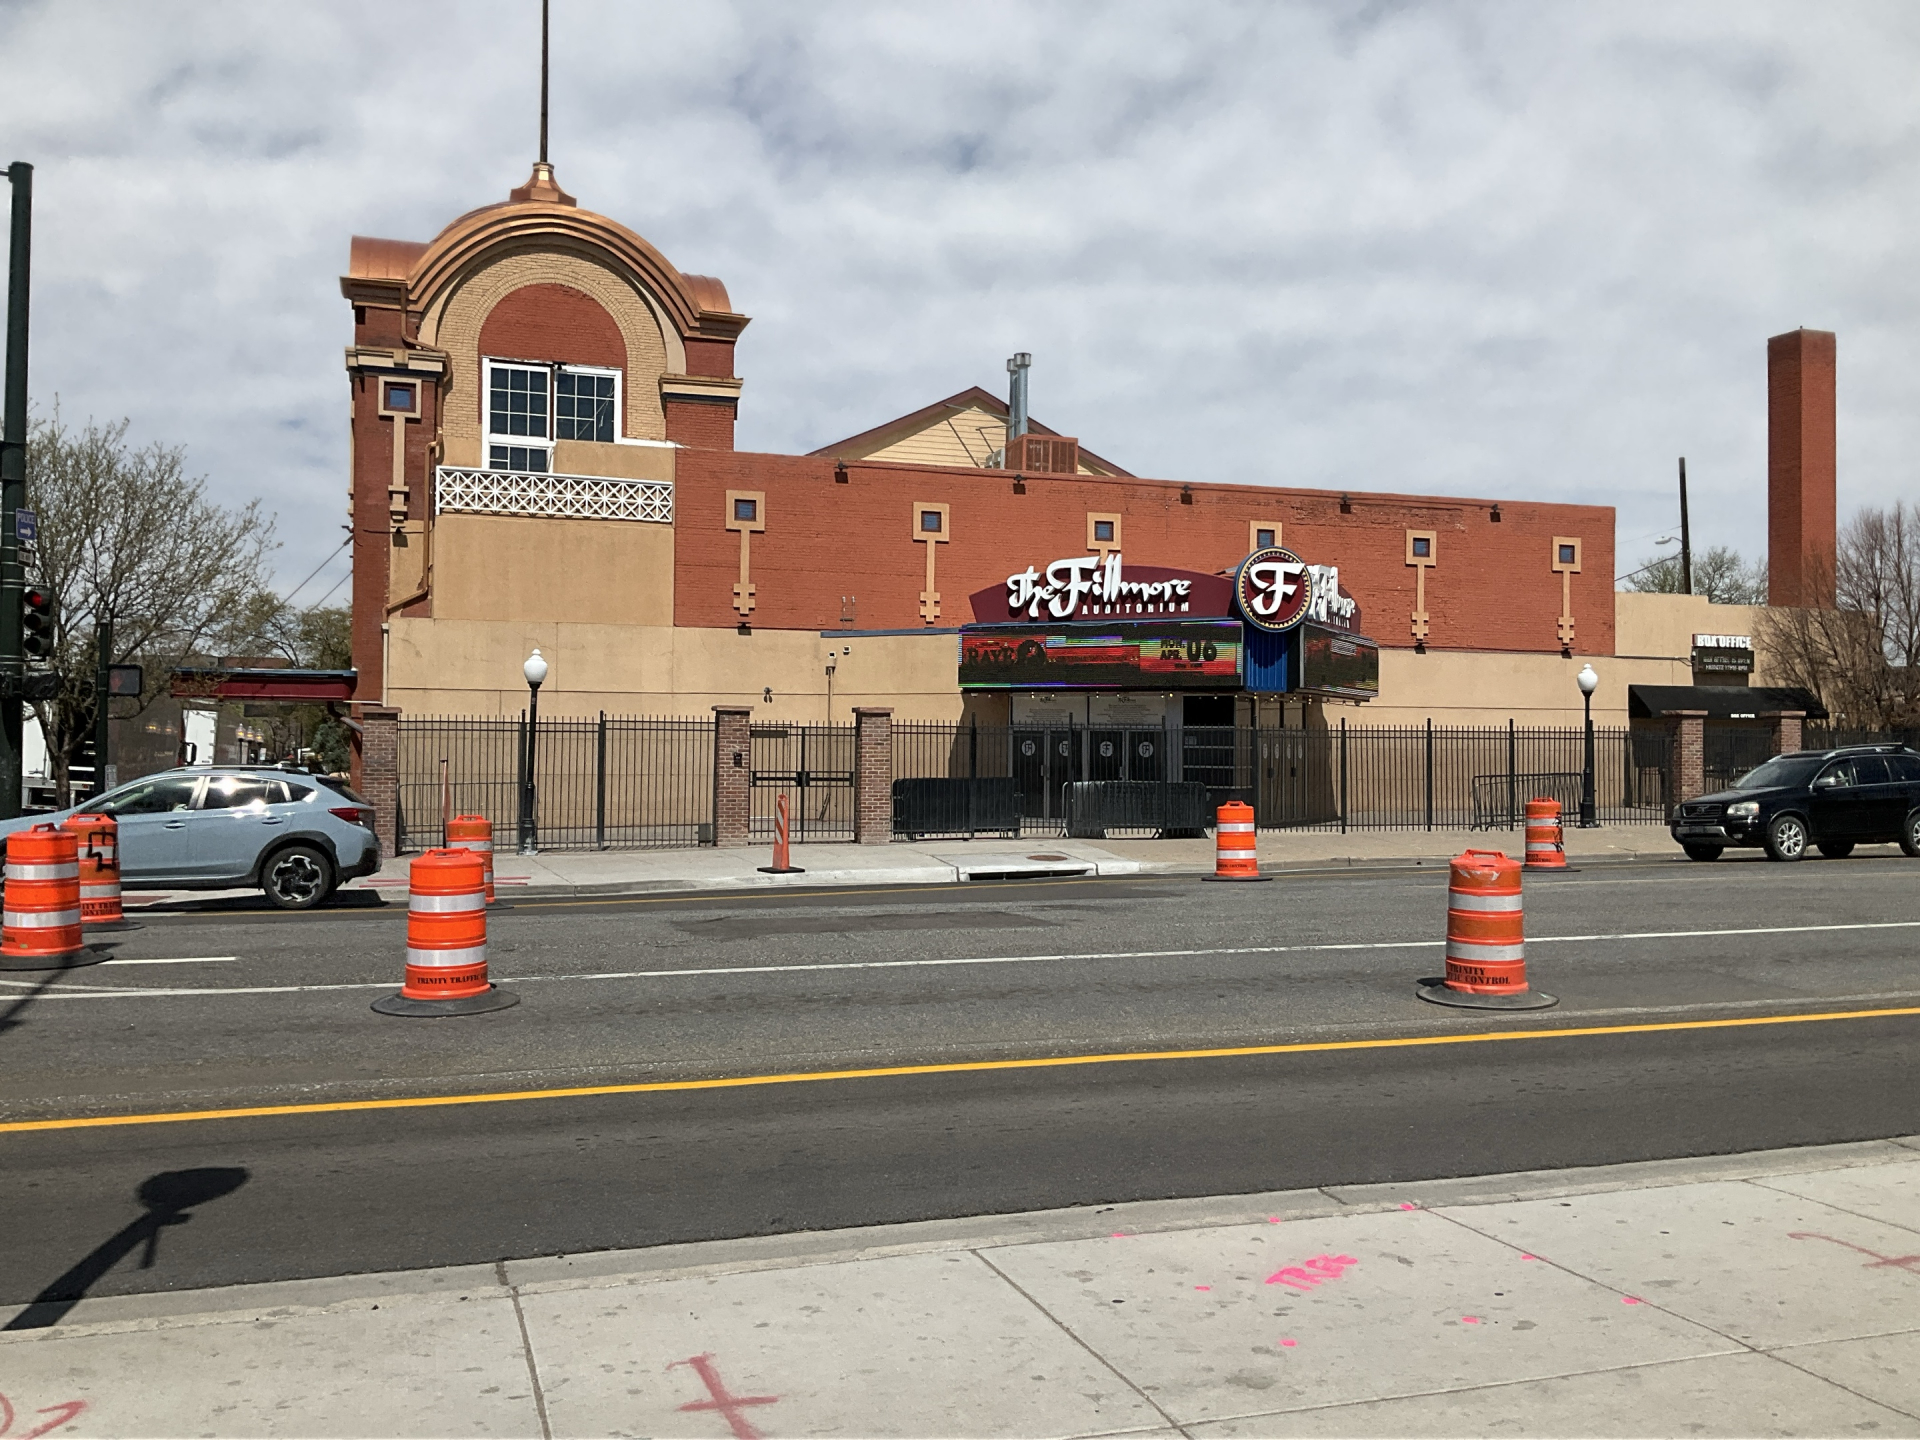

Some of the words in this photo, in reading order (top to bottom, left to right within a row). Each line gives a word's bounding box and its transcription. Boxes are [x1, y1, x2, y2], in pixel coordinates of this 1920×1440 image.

[1007, 565, 1055, 617] The
[1046, 554, 1192, 617] Fillmore
[1081, 602, 1189, 615] AUDITORIUM
[1697, 635, 1718, 647] BOX
[1718, 636, 1751, 648] OFFICE
[1187, 638, 1218, 661] 06
[417, 977, 447, 985] TRINITY
[1464, 974, 1510, 984] CONTROL
